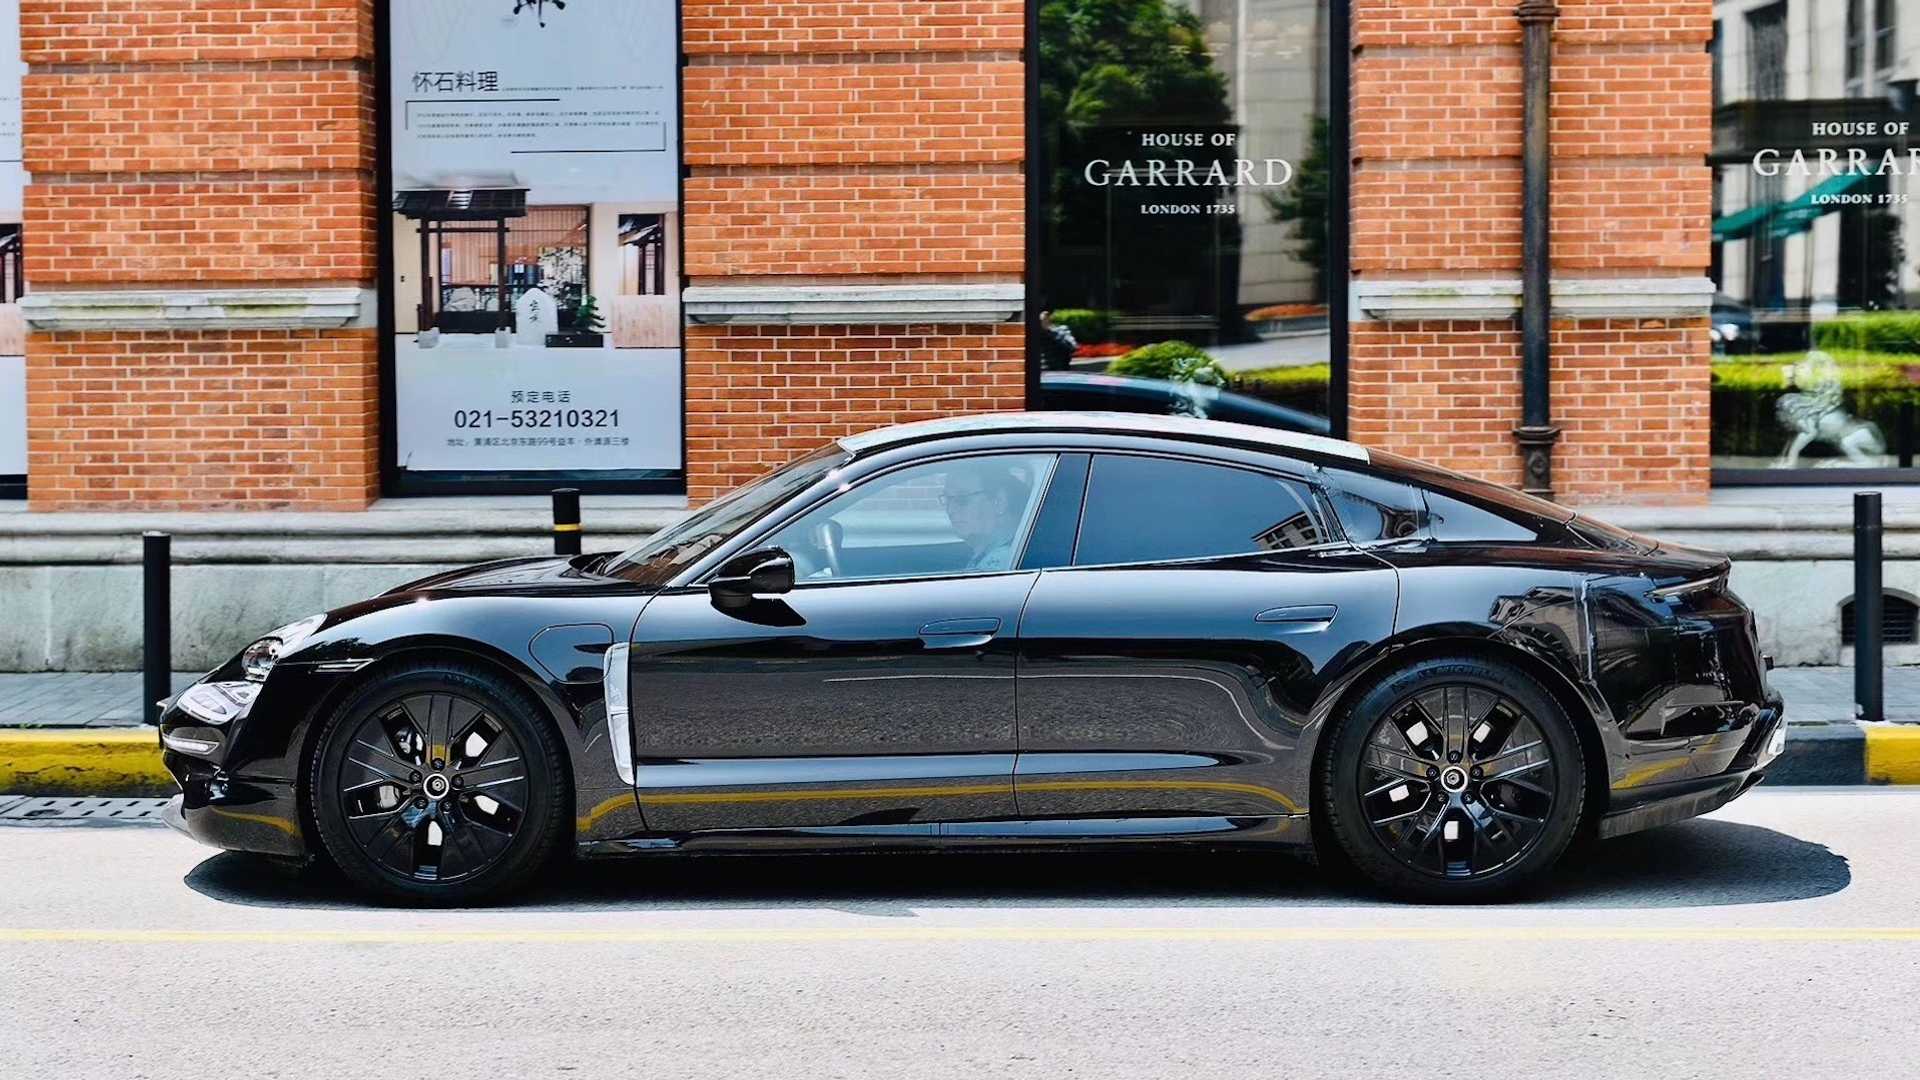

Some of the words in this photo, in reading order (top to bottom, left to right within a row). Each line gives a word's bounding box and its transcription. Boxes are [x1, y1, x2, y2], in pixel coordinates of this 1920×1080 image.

[412, 71, 499, 93] 怀石料理
[1812, 122, 1877, 136] HOUSE
[1884, 122, 1910, 135] OF
[1142, 133, 1204, 147] HOUSE
[1211, 133, 1236, 146] OF
[1084, 159, 1293, 186] GARRARD
[1811, 194, 1873, 205] LONDON
[1878, 194, 1909, 205] 1735
[1141, 204, 1201, 215] LONDON
[1206, 204, 1236, 215] 1735
[511, 391, 571, 403] 预定电话
[454, 409, 620, 428] 021-53210321
